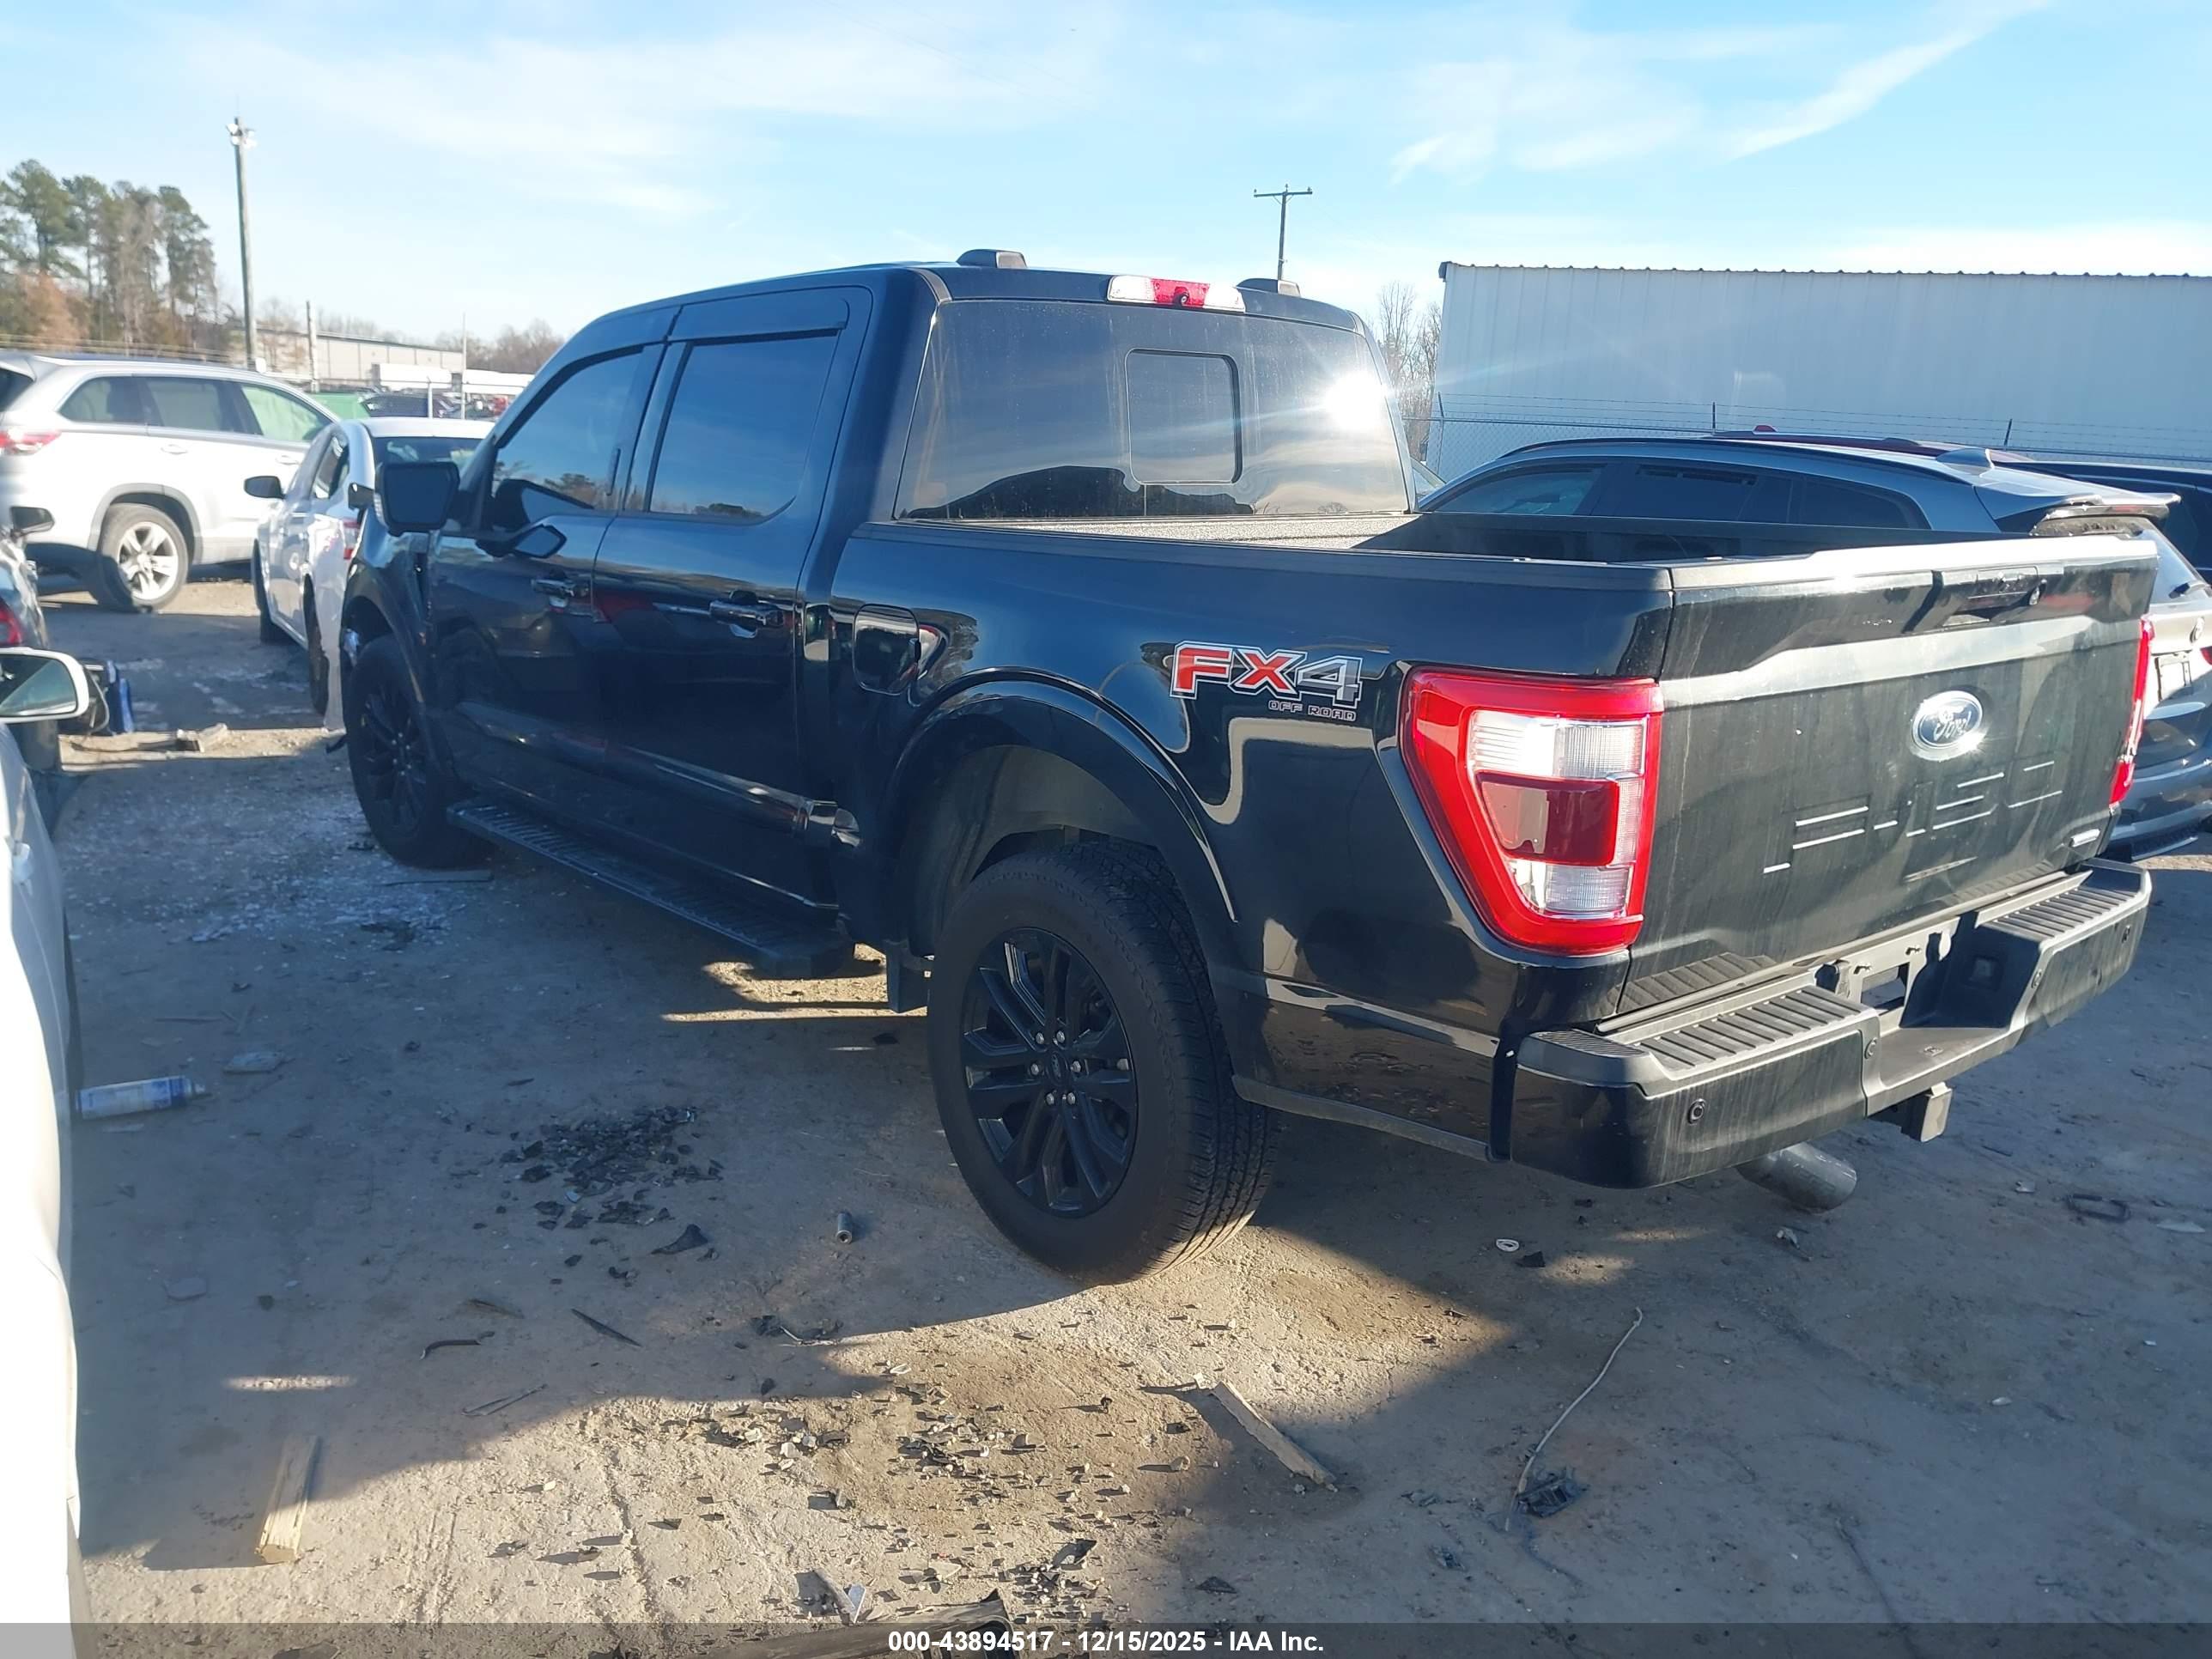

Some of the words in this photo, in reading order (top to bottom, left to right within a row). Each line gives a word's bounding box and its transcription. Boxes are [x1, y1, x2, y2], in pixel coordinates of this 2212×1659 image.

[1170, 641, 1364, 709] FX4
[1268, 700, 1303, 713] OFF
[1308, 705, 1357, 721] ROAD
[1932, 707, 1974, 742] Ford
